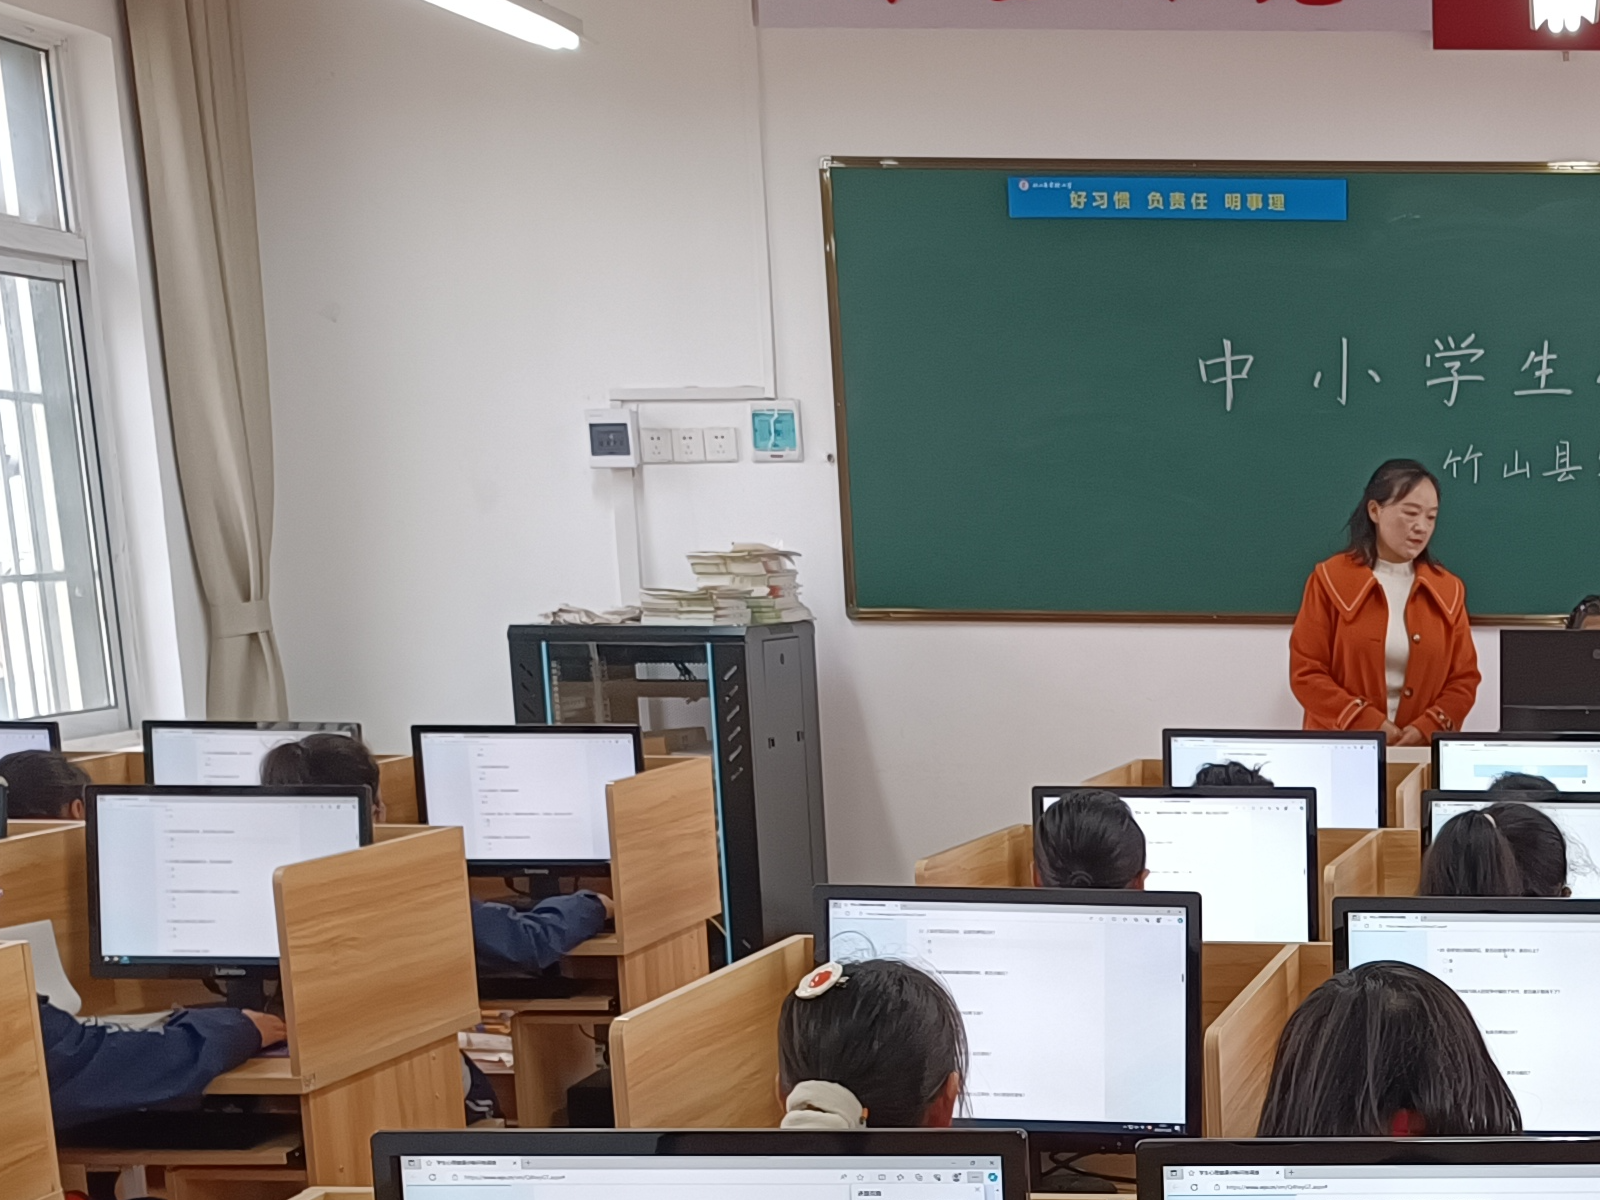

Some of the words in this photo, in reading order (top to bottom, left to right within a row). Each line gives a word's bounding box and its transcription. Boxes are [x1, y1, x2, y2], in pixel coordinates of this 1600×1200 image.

[1069, 191, 1131, 209] 好习惯
[1147, 192, 1208, 210] 负责任
[1224, 193, 1285, 211] 明事理
